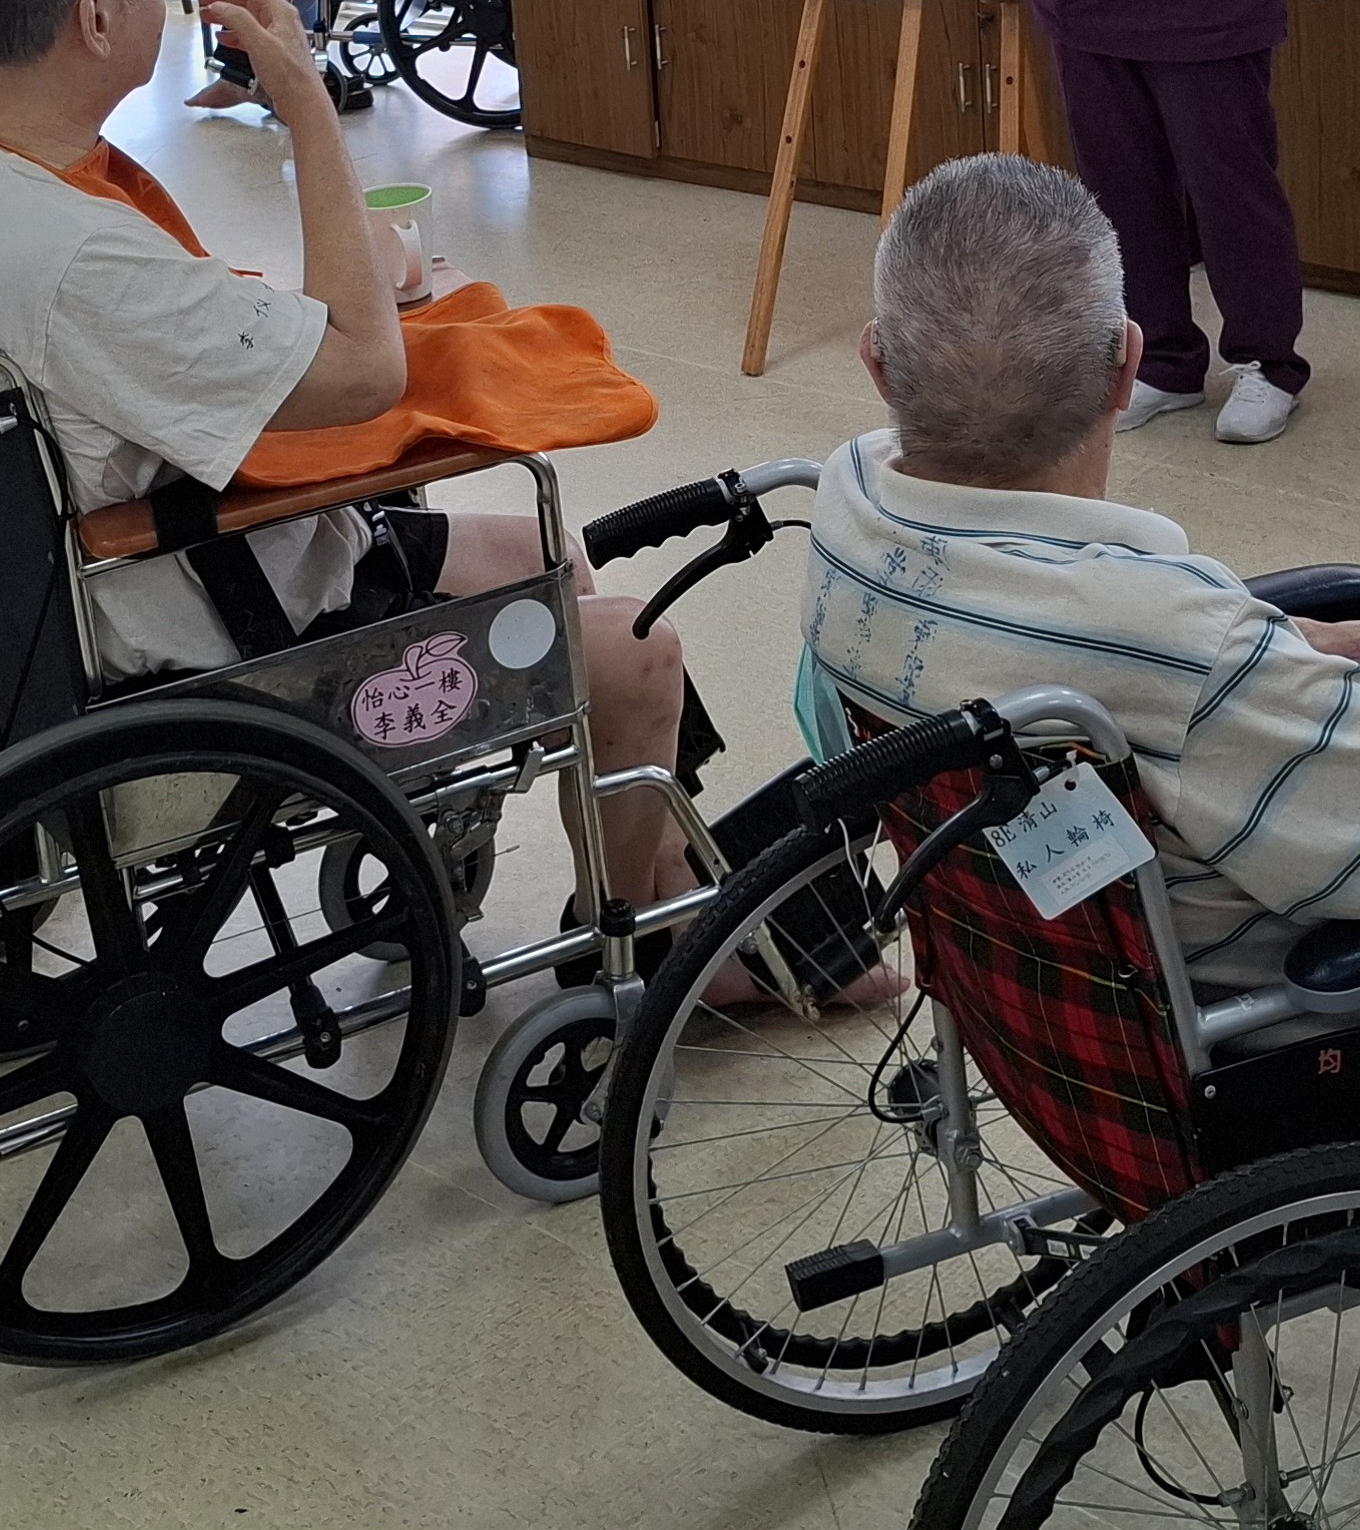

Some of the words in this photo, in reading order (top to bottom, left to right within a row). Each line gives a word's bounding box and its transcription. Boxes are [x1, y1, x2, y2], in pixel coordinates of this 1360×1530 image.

[361, 667, 464, 712] 怡心一樓
[373, 699, 457, 740] 李義全
[1016, 809, 1115, 881] 私人輪椅
